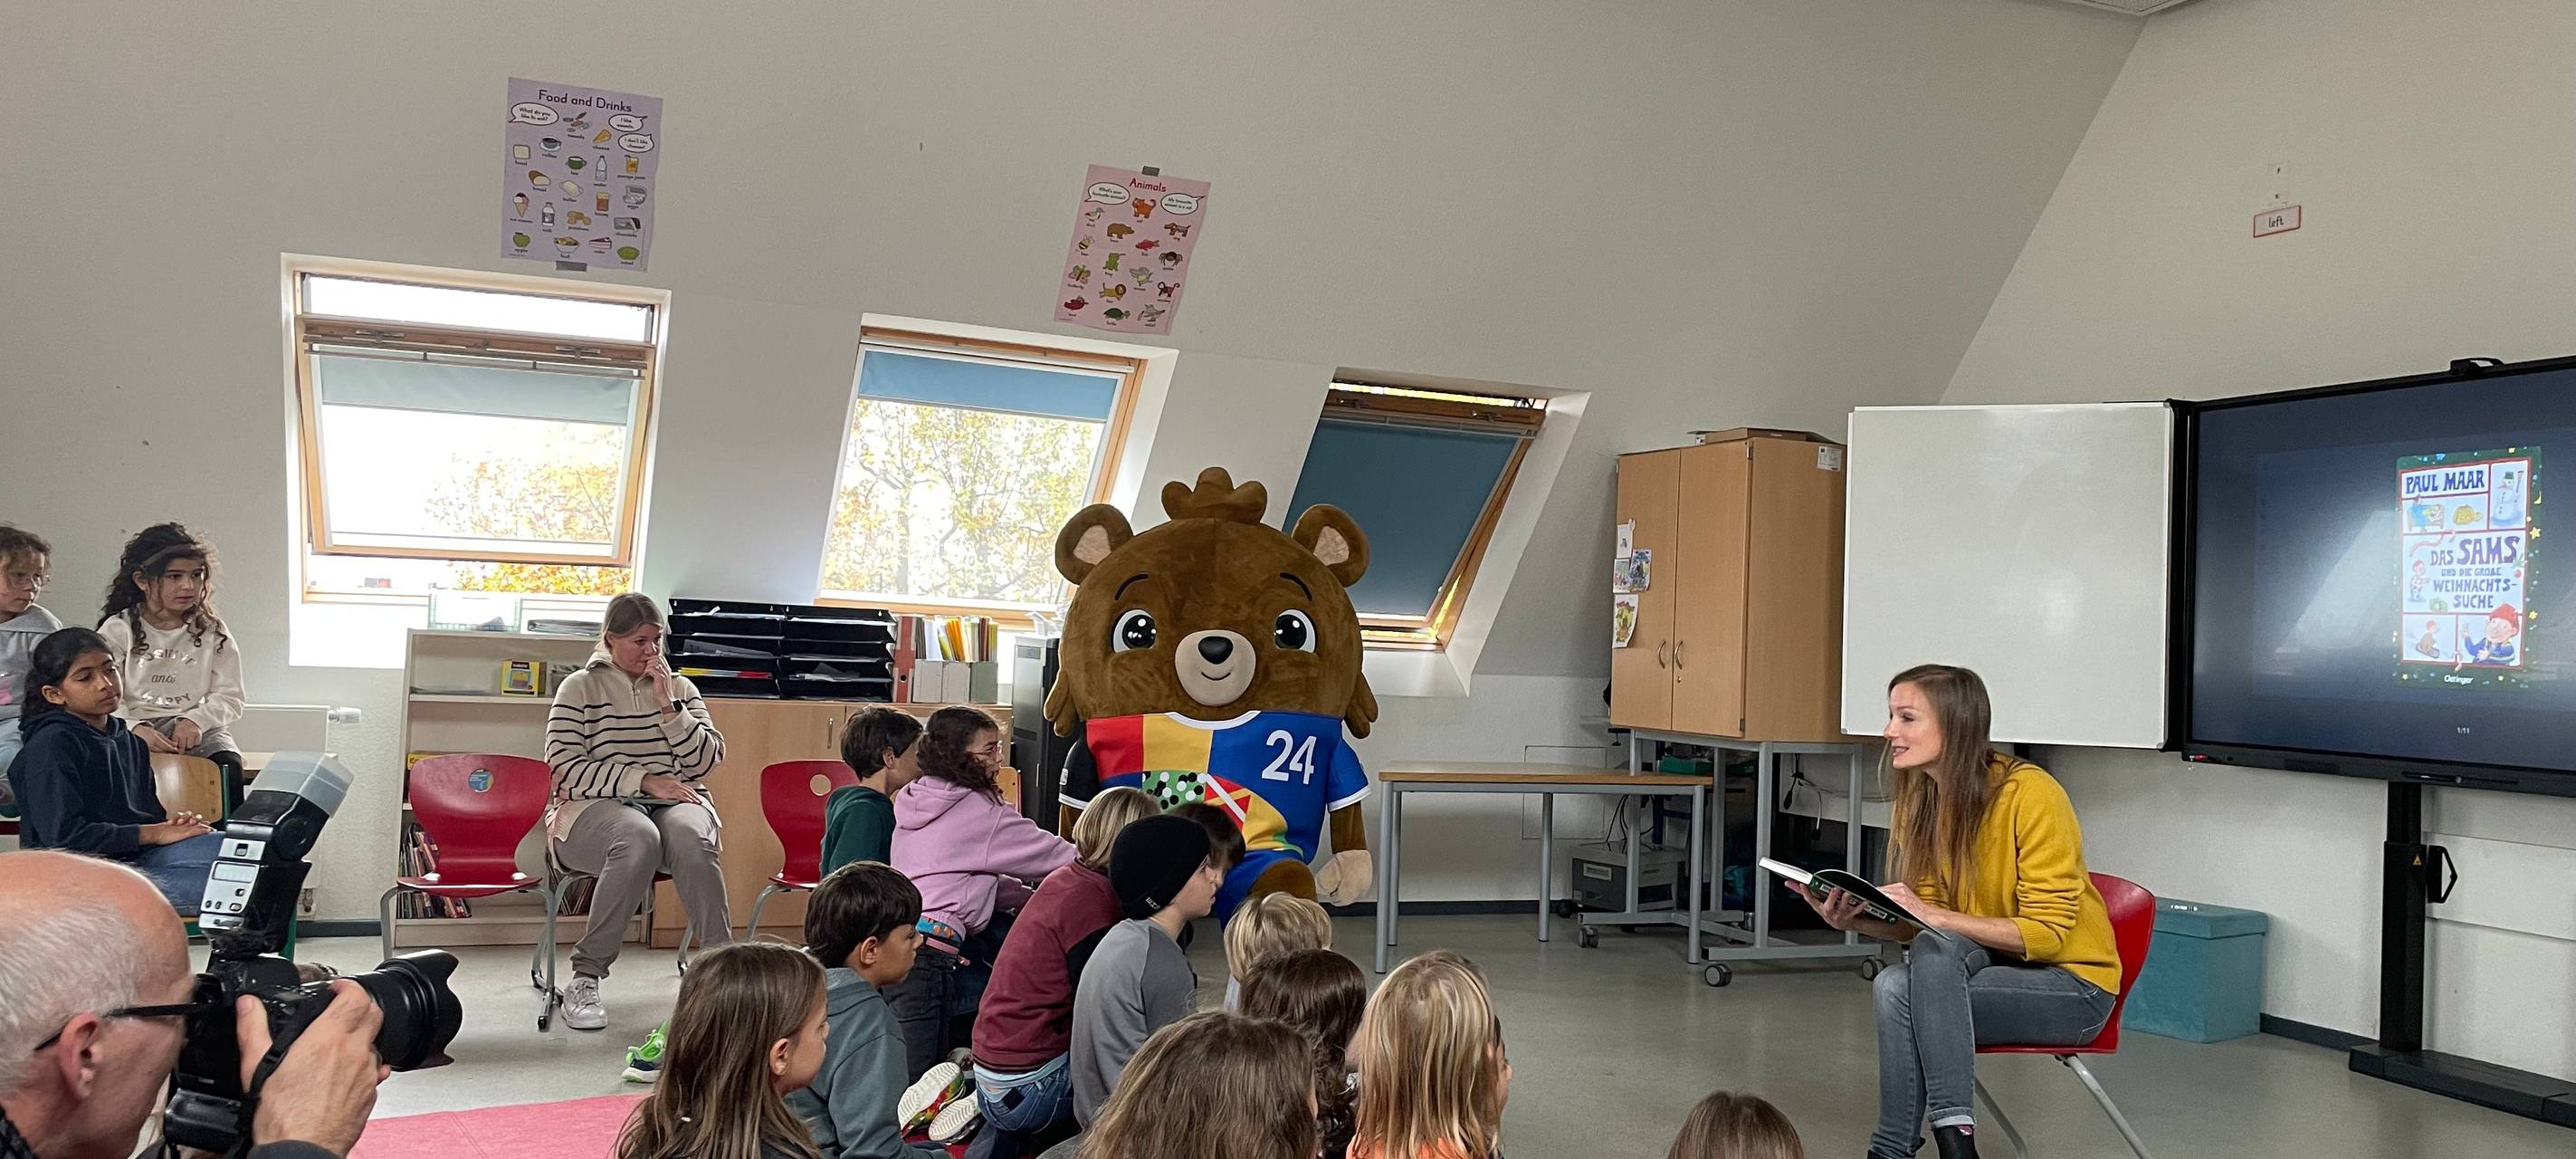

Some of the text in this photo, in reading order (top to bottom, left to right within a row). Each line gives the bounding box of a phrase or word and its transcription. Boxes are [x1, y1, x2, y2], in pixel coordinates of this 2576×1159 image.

[539, 90, 632, 112] Food and Drinks
[1129, 177, 1167, 193] Animals
[2268, 216, 2284, 228] left
[2406, 470, 2485, 493] PAUL MAAR
[2430, 536, 2520, 566] DAS SAMS
[2459, 568, 2473, 576] DIE
[2433, 579, 2517, 593] WEIHNACHTS-
[2453, 594, 2494, 608] SUCHE
[1261, 729, 1318, 785] 24
